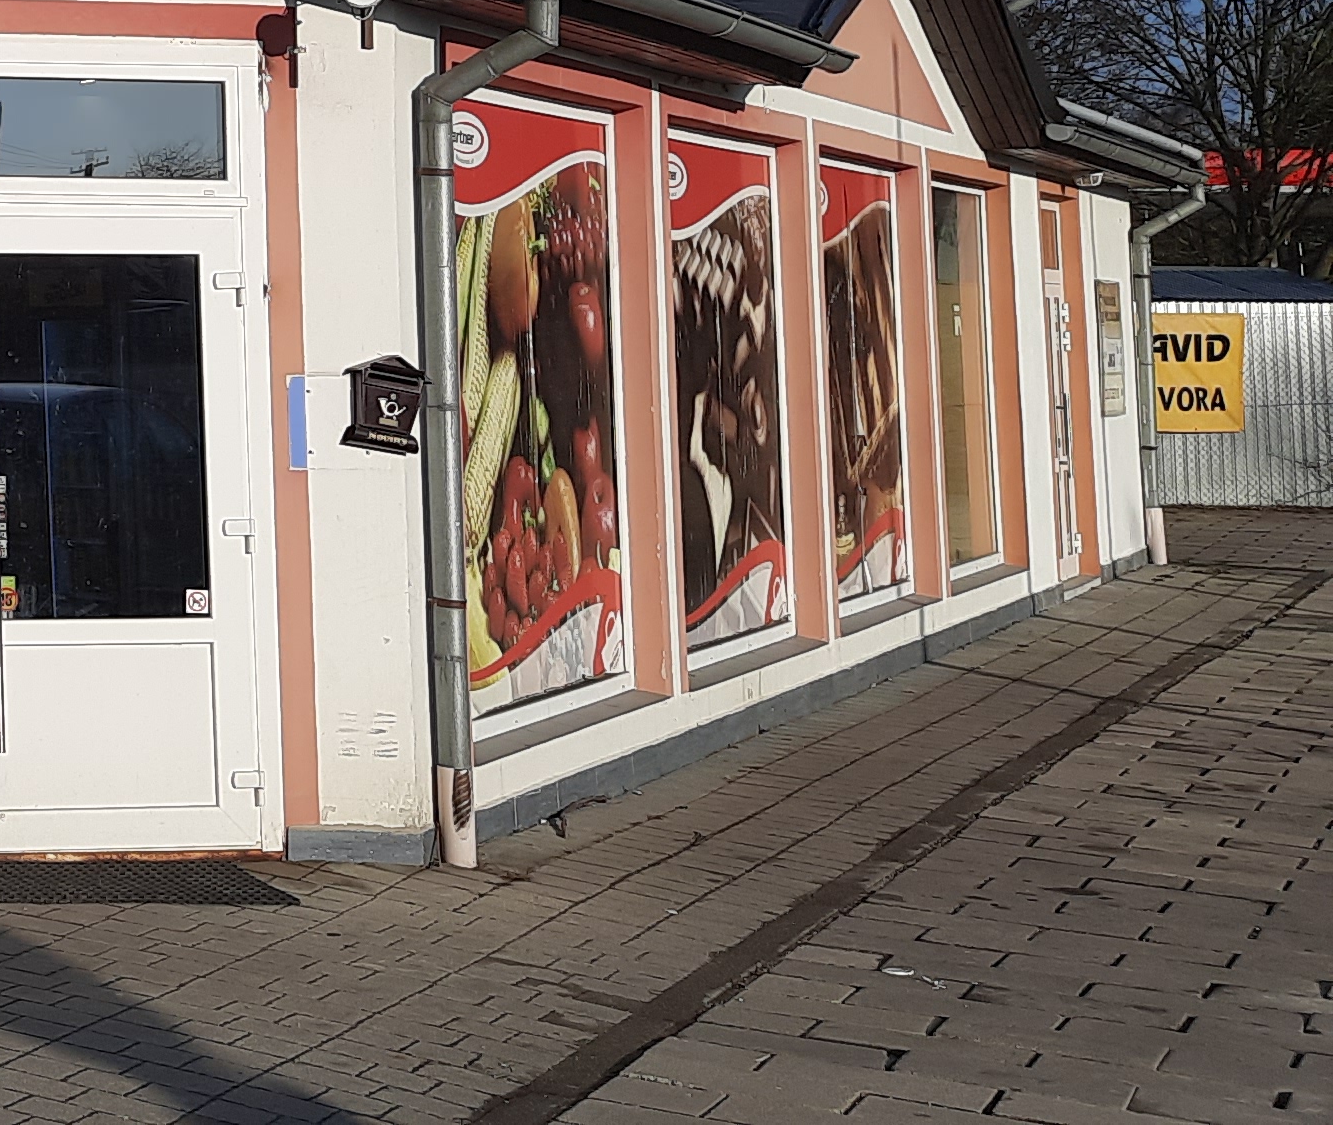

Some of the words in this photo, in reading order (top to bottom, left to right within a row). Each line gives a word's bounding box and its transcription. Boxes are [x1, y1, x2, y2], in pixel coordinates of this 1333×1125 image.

[452, 129, 475, 145] artner
[1153, 333, 1231, 363] AVID
[1156, 386, 1227, 412] VORA
